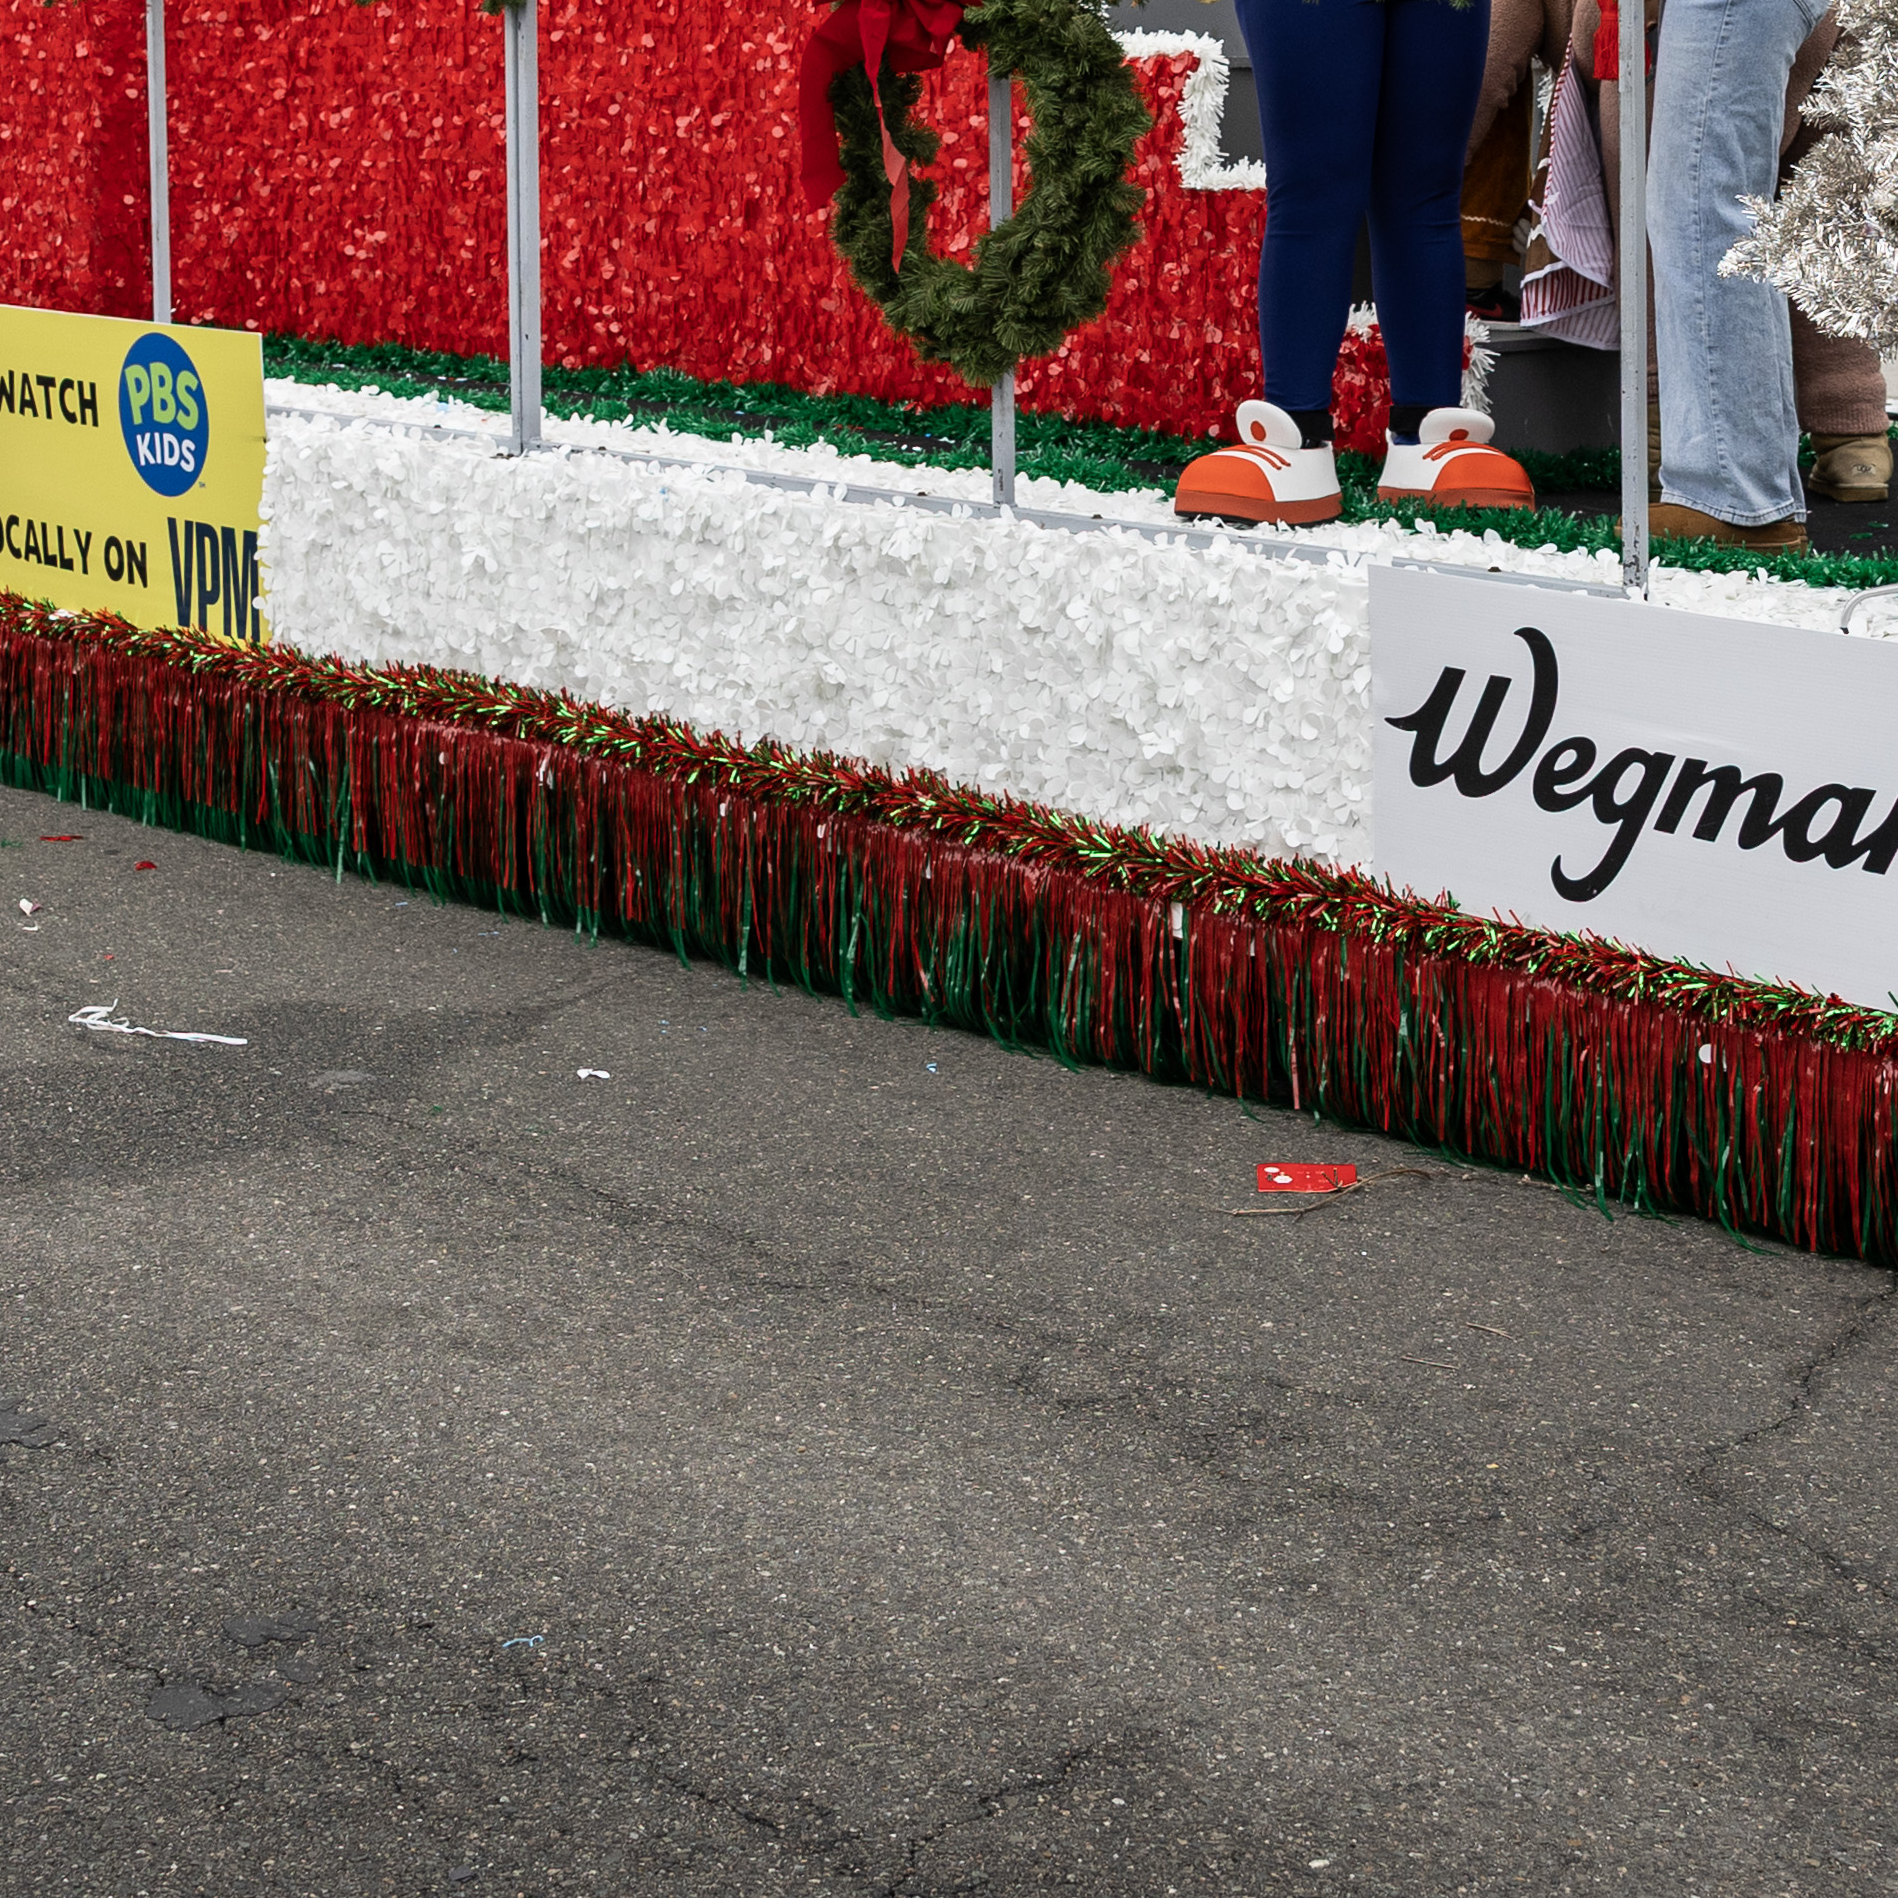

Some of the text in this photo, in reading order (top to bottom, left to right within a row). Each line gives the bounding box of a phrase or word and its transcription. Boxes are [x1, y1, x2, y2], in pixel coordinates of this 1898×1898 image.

[125, 362, 199, 431] PBS
[136, 432, 196, 473] KIDS
[104, 535, 148, 588] ON
[167, 516, 260, 643] VPM
